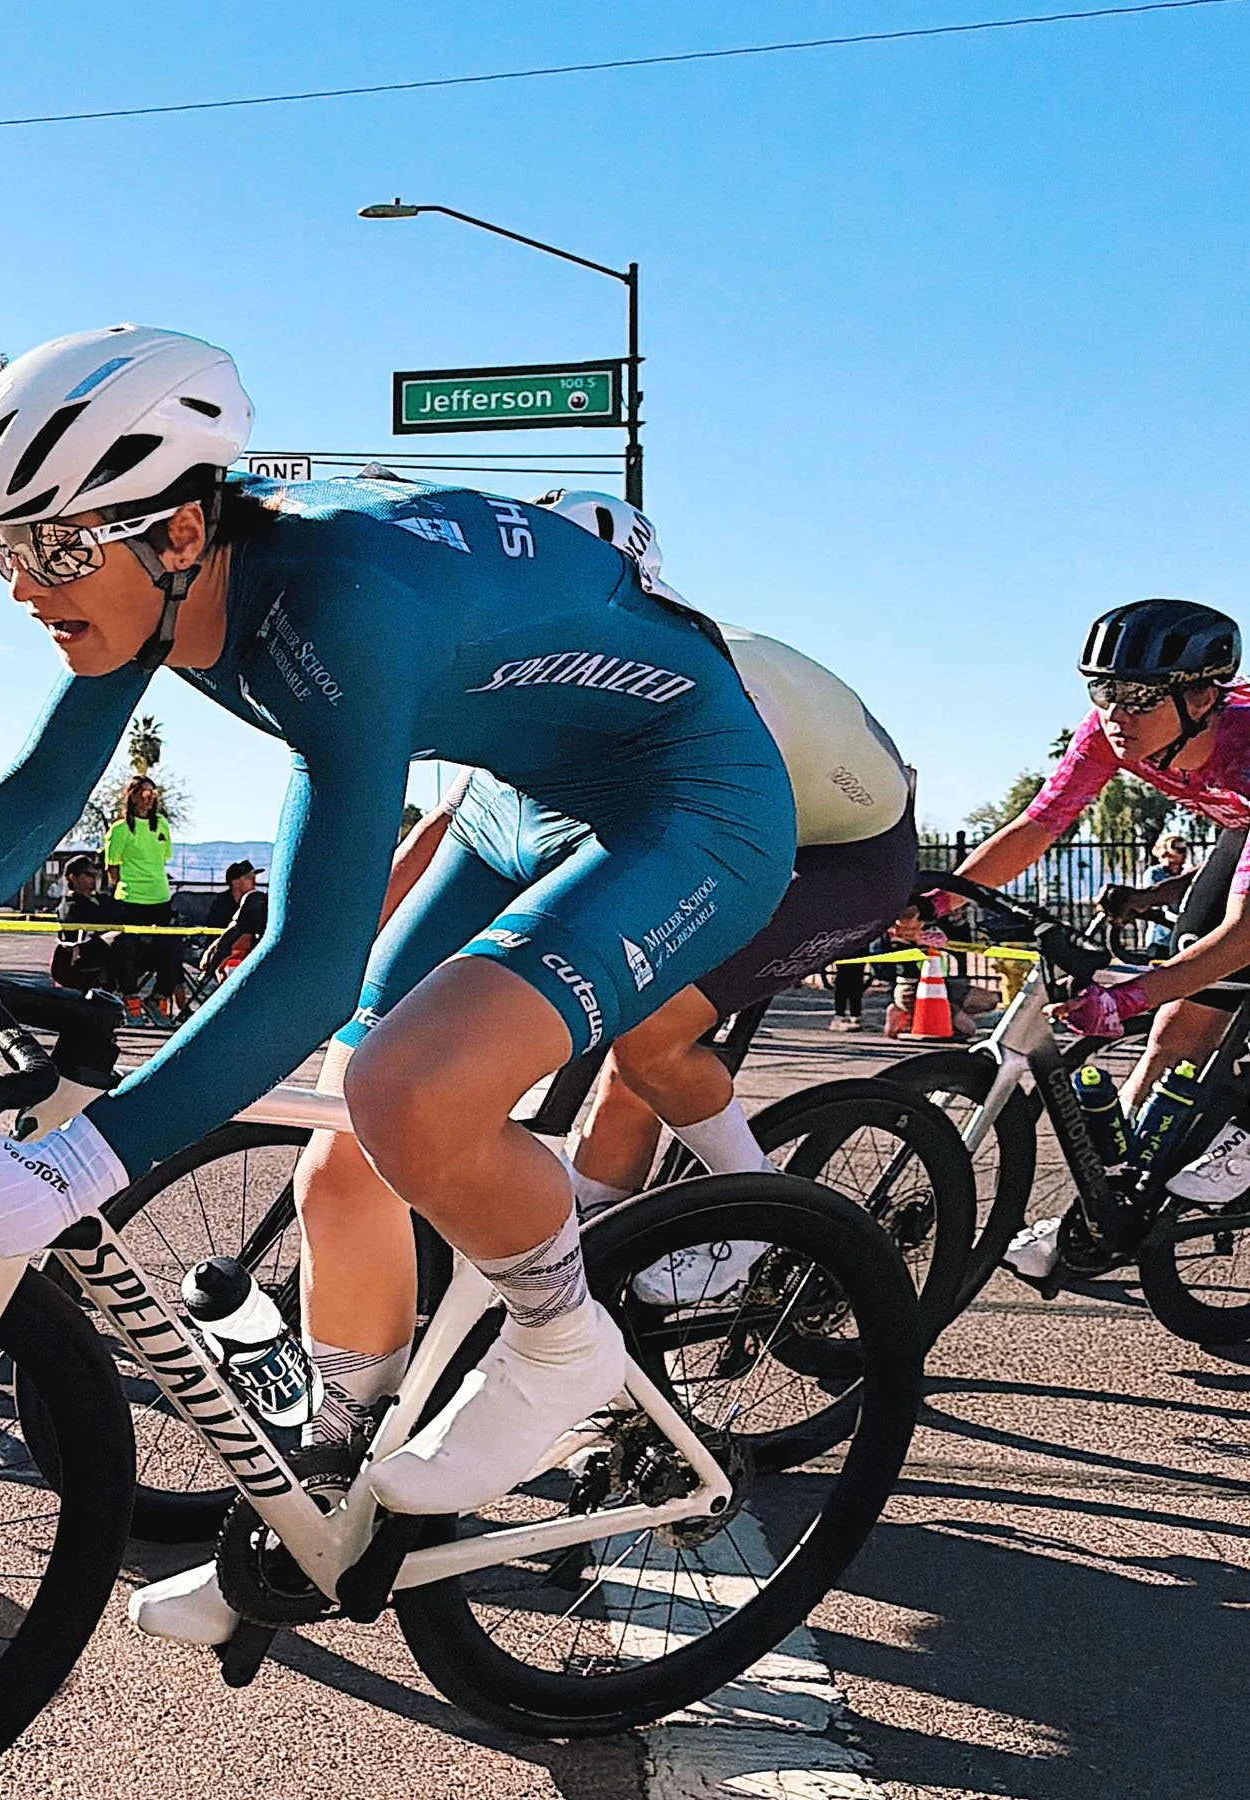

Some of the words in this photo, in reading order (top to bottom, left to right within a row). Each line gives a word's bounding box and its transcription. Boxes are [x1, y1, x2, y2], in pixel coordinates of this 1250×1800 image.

[419, 388, 553, 414] Jefferson
[294, 641, 345, 706] SCHOOL
[464, 651, 697, 704] SPECIALIZED
[643, 909, 685, 953] MILLER
[678, 876, 719, 918] SCHOOL
[665, 900, 719, 959] ALBEMARLE
[66, 1242, 294, 1498] SPECIALIZED
